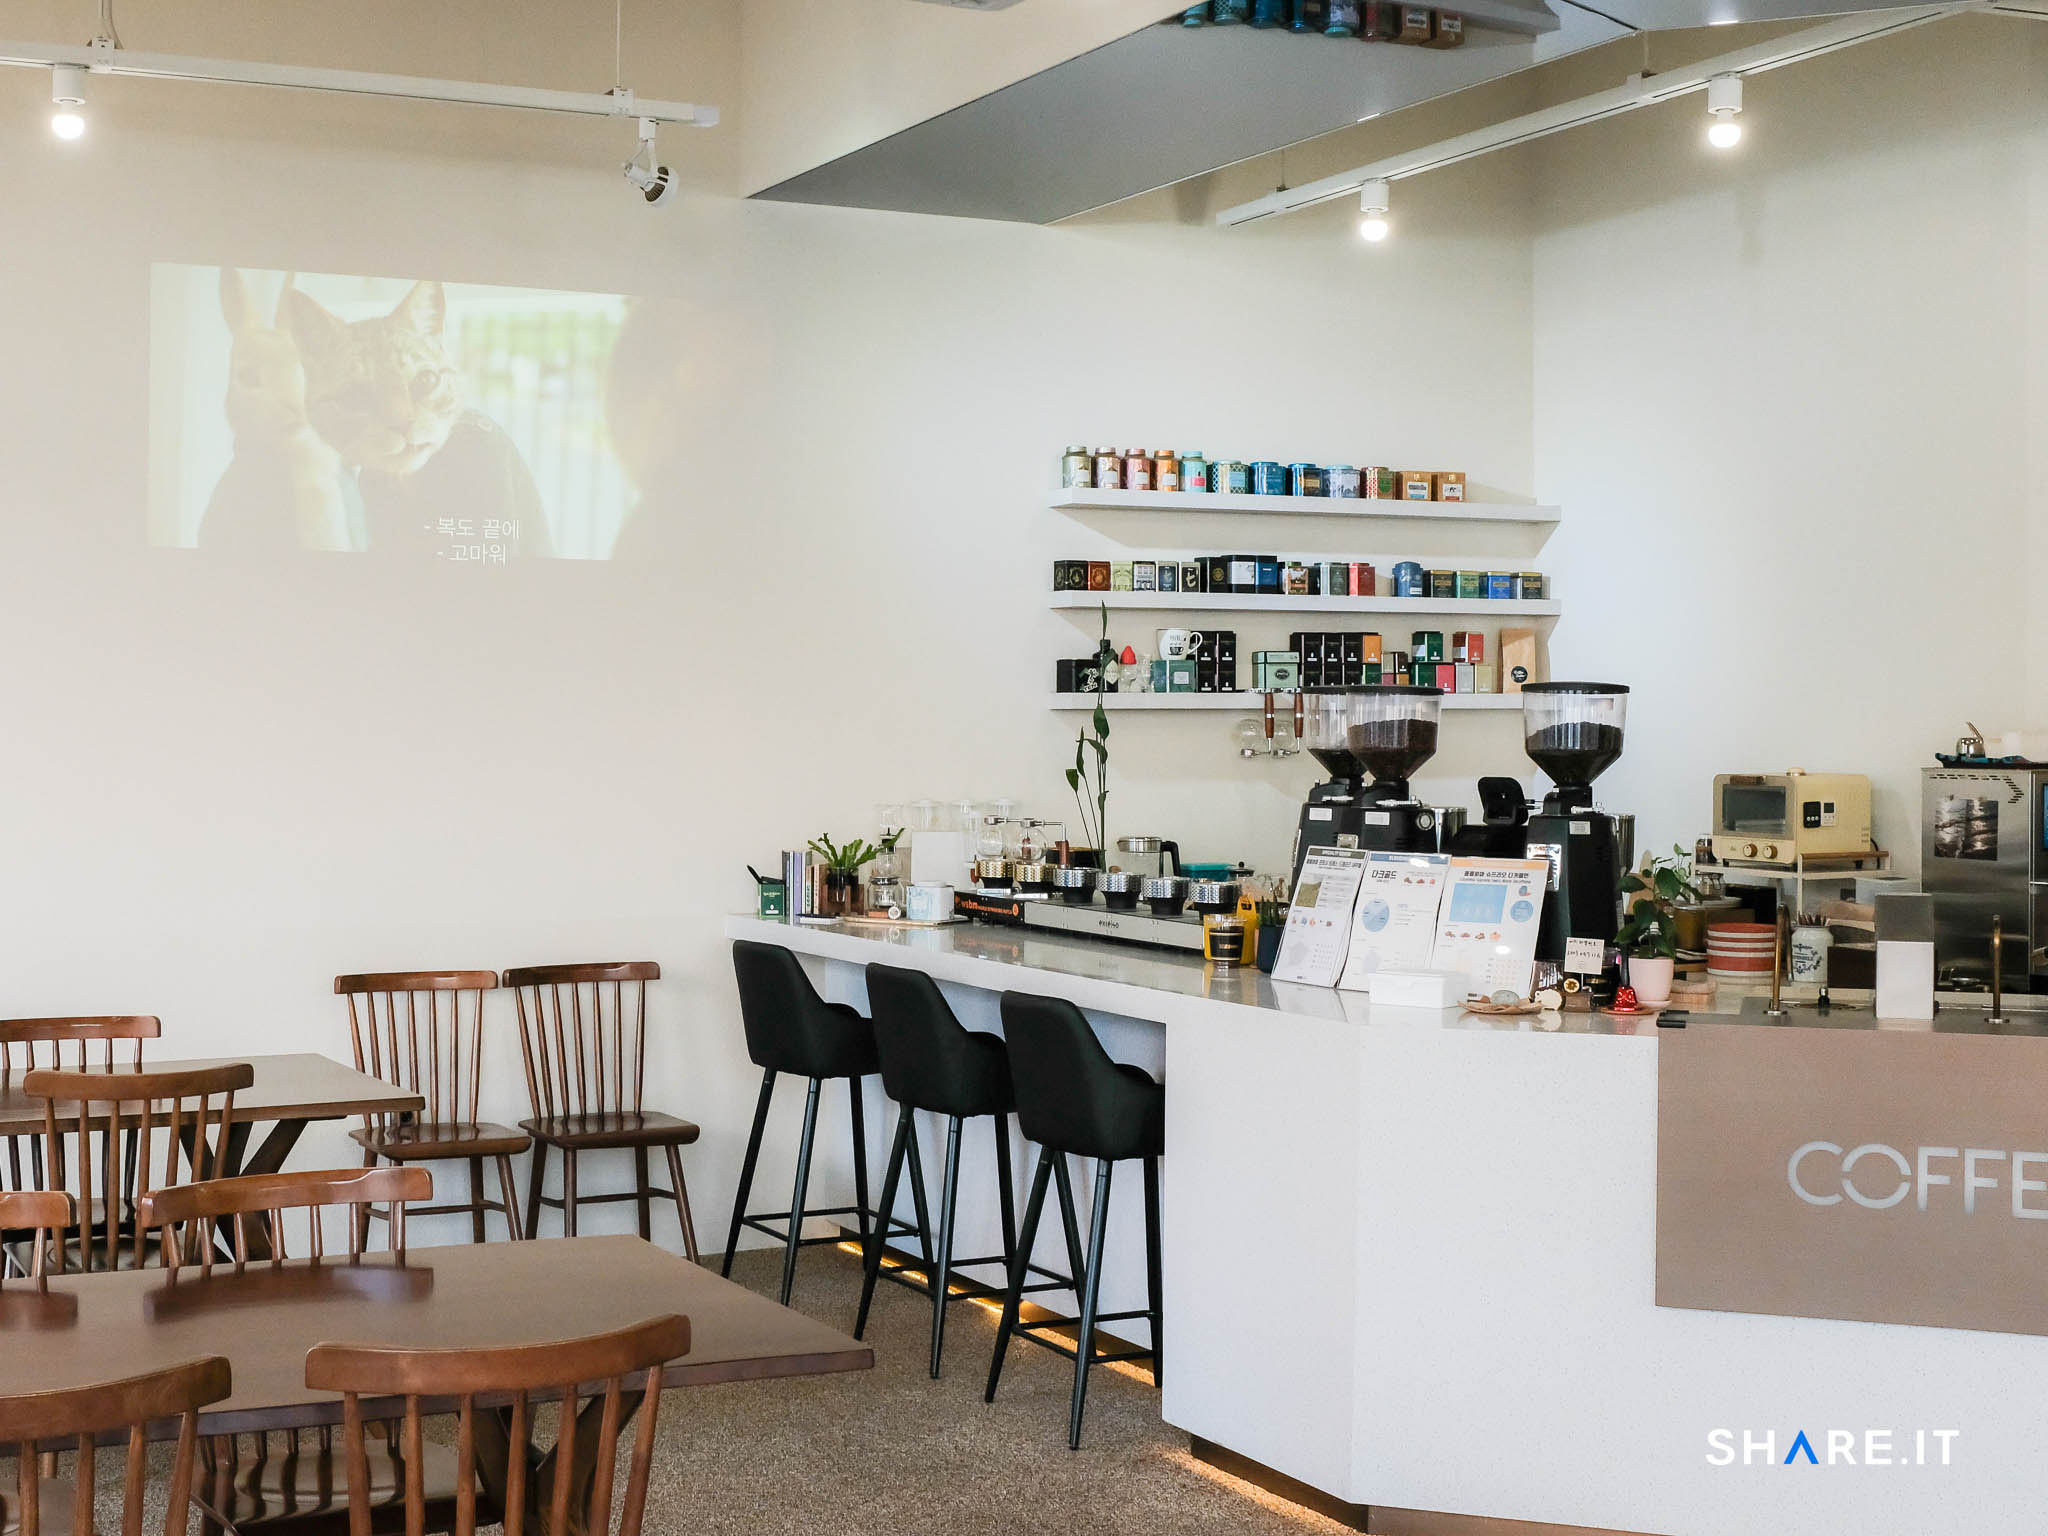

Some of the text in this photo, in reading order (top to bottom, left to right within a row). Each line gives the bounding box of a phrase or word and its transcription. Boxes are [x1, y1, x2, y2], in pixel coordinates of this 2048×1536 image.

[437, 517, 476, 537] 복도
[482, 519, 520, 539] 끝에
[448, 544, 506, 565] 고마워
[1788, 1141, 2048, 1220] COFFE
